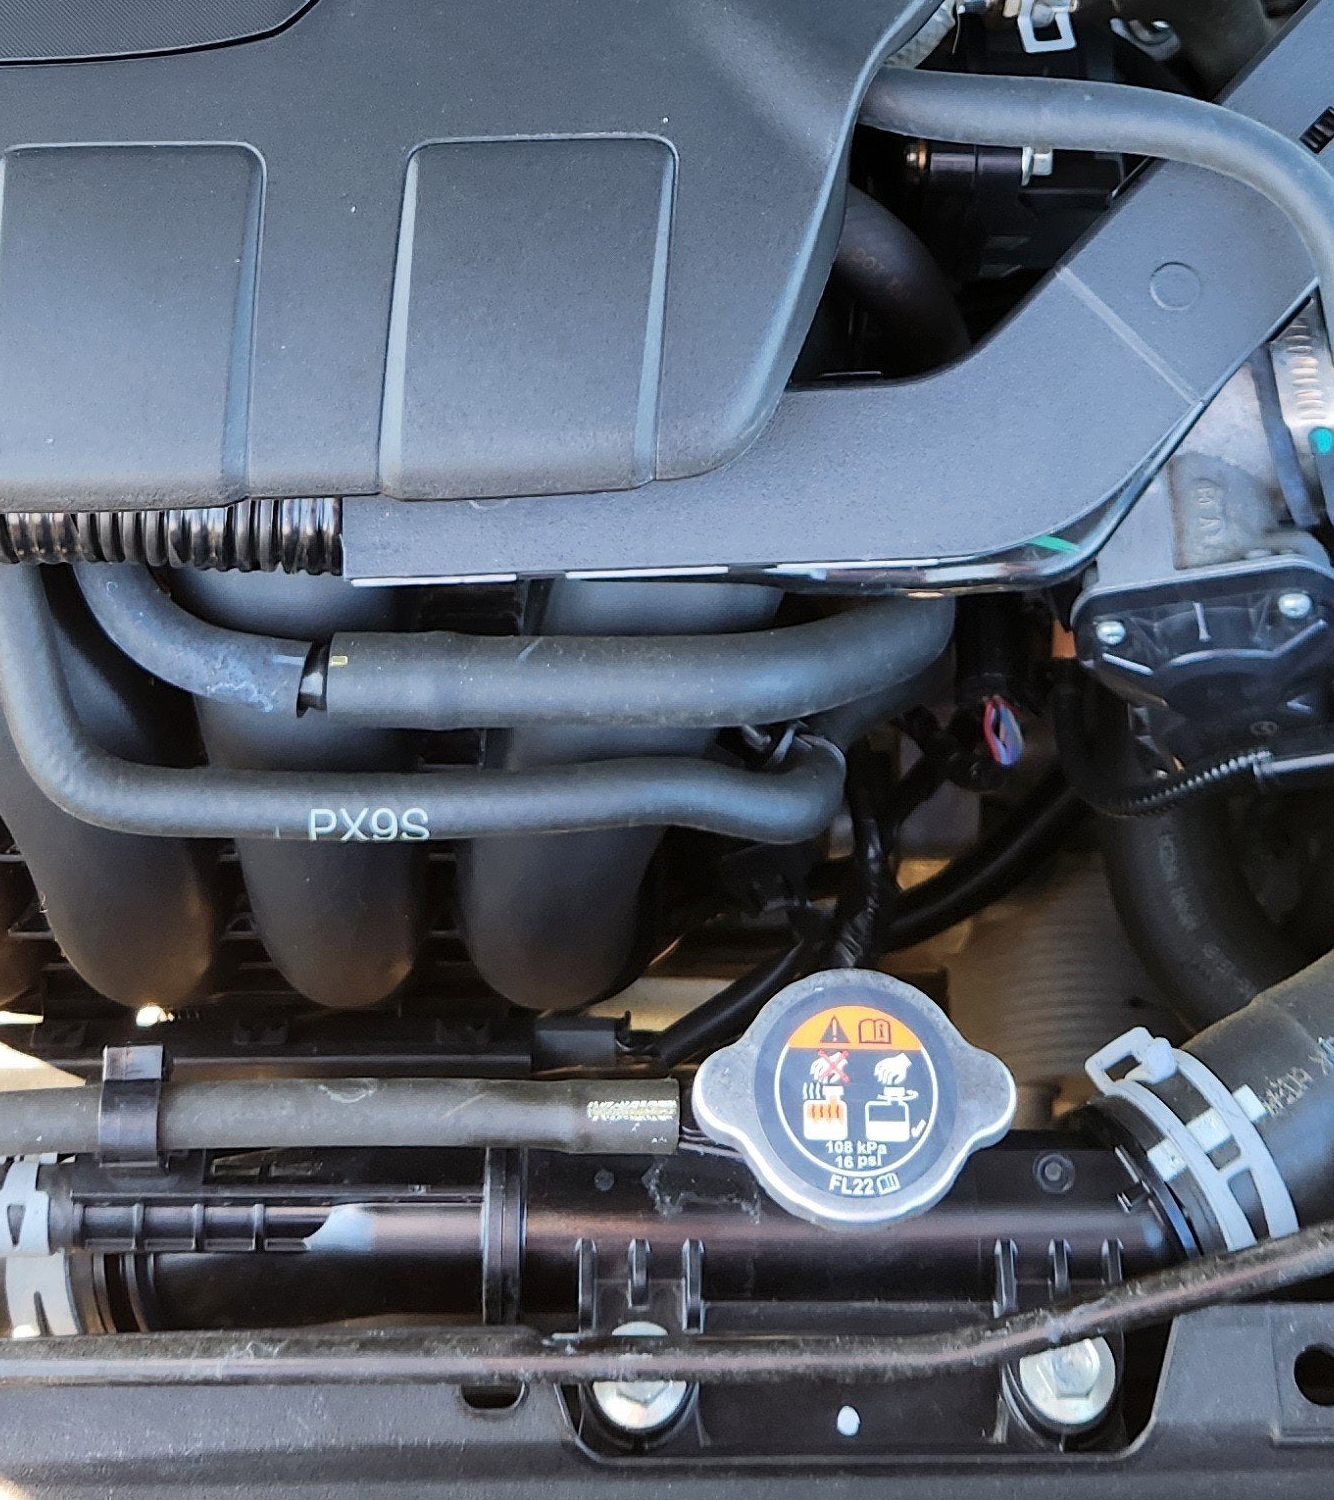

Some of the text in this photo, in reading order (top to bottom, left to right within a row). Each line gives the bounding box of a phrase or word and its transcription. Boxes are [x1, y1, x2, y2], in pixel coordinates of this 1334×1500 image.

[308, 807, 430, 842] PX9S
[825, 1141, 887, 1155] 108 kPa
[835, 1155, 882, 1169] 16 psi
[829, 1173, 875, 1195] FL22
